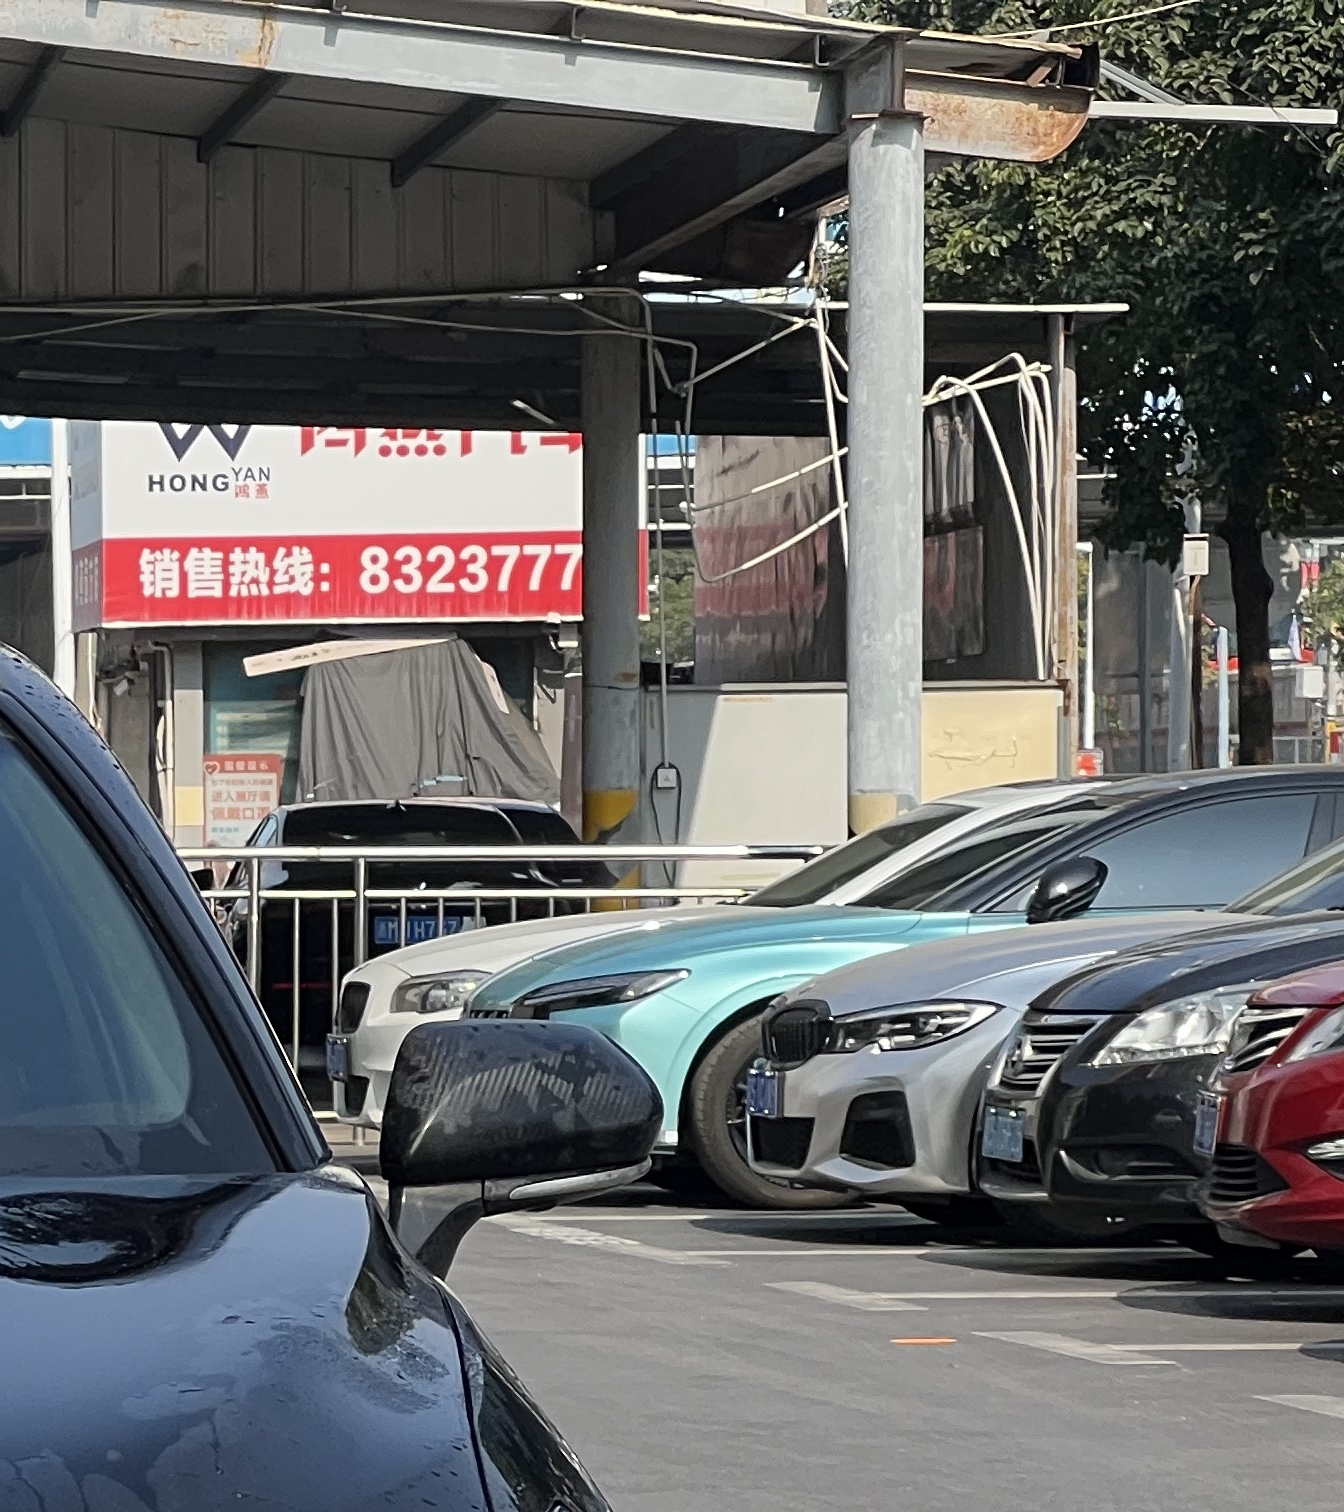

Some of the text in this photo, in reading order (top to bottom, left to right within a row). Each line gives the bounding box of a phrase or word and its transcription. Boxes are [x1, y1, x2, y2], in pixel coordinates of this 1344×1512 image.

[148, 466, 270, 492] HONG YAN
[139, 546, 330, 598] 销售热线：
[359, 543, 583, 594] 8323777
